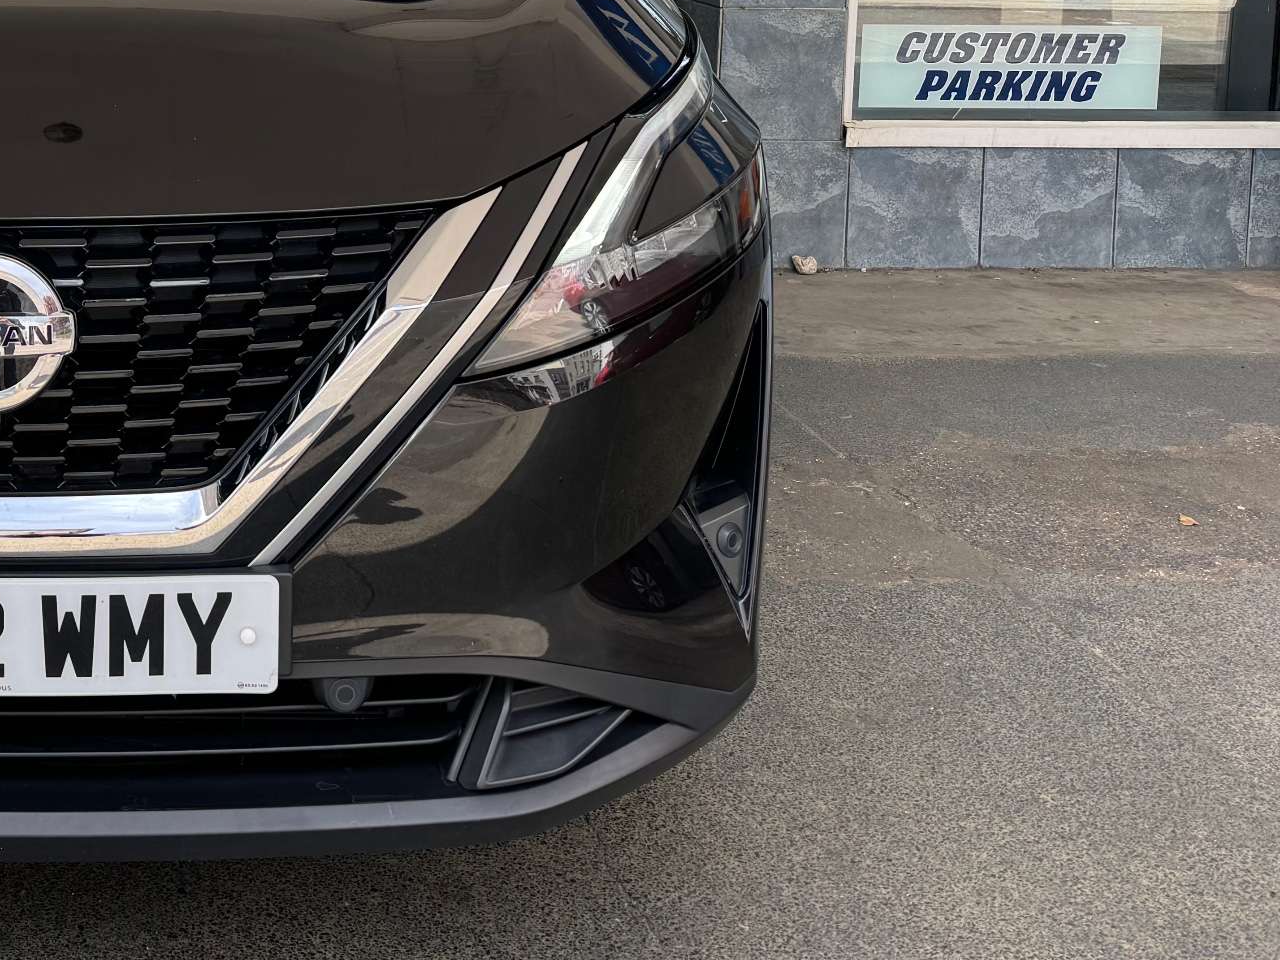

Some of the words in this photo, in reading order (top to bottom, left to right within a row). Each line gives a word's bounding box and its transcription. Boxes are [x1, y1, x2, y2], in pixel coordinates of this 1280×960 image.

[895, 31, 1127, 65] CUSTOMER
[914, 69, 1103, 103] PARKING
[40, 591, 234, 679] WMY
